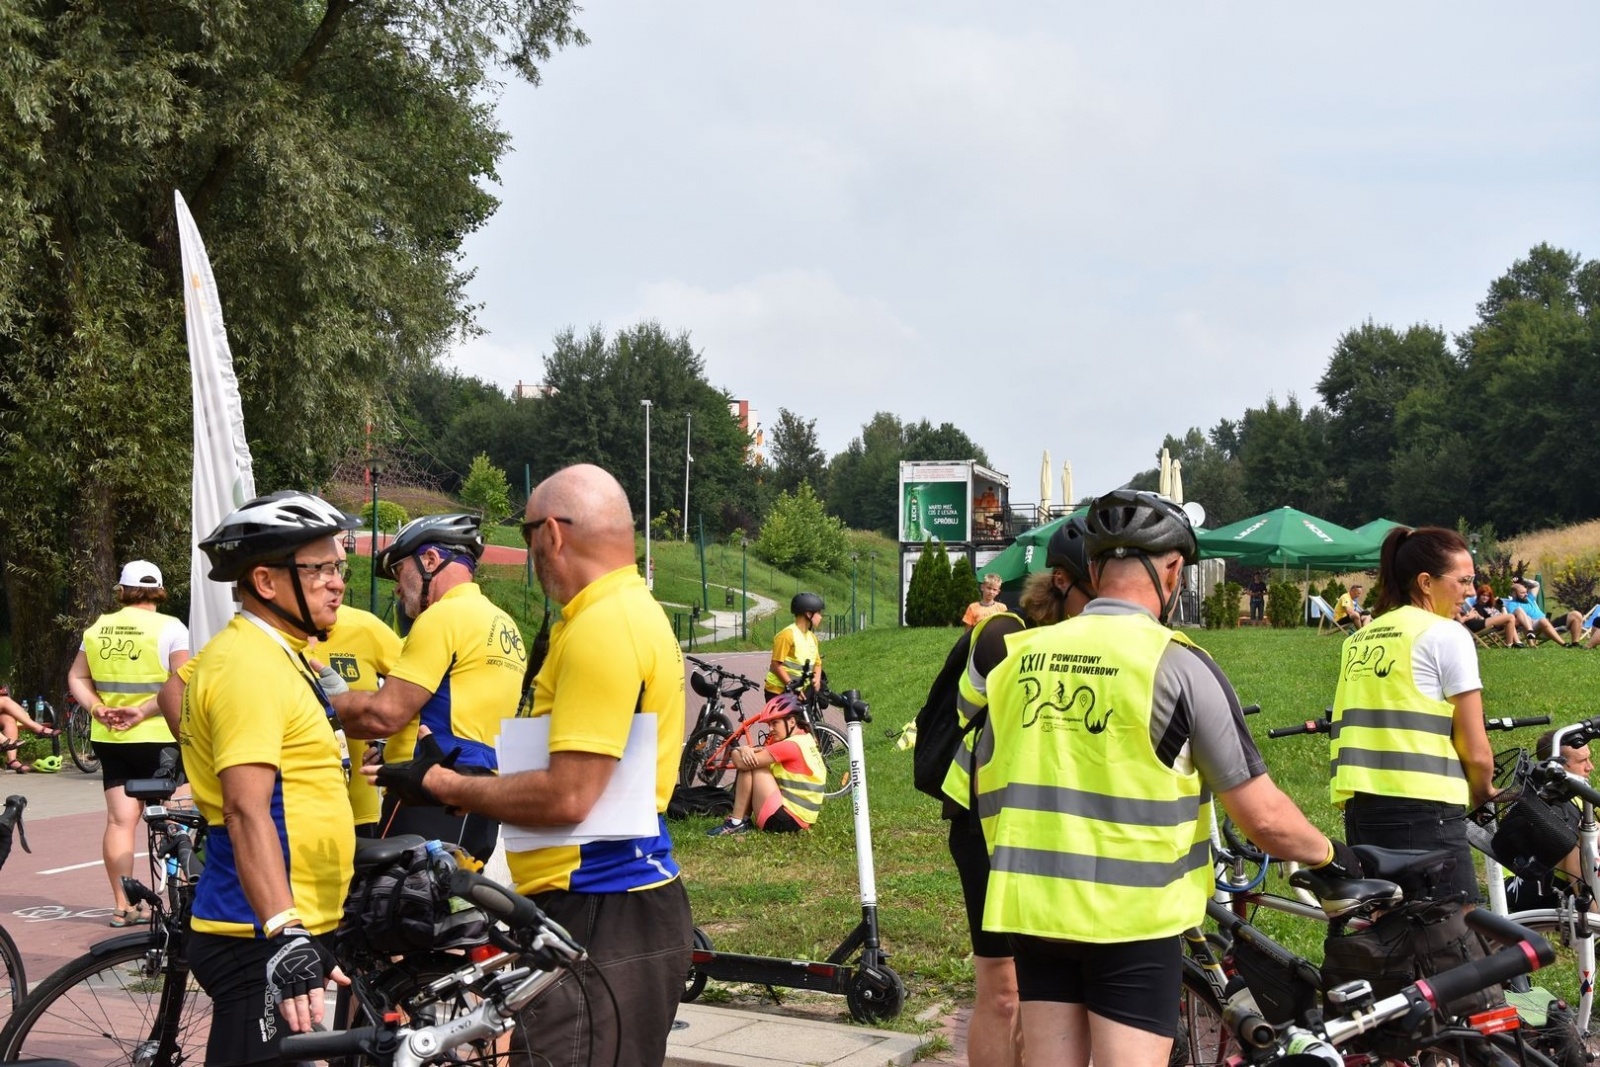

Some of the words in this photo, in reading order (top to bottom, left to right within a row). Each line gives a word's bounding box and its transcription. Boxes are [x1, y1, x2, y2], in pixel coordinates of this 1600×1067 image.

[933, 517, 959, 525] SPRÓBUJ
[215, 540, 241, 550] MET
[1019, 653, 1046, 674] XXII
[1051, 653, 1102, 665] POWIATOWY
[1049, 664, 1069, 673] RAJD
[1071, 665, 1119, 677] ROWEROWY
